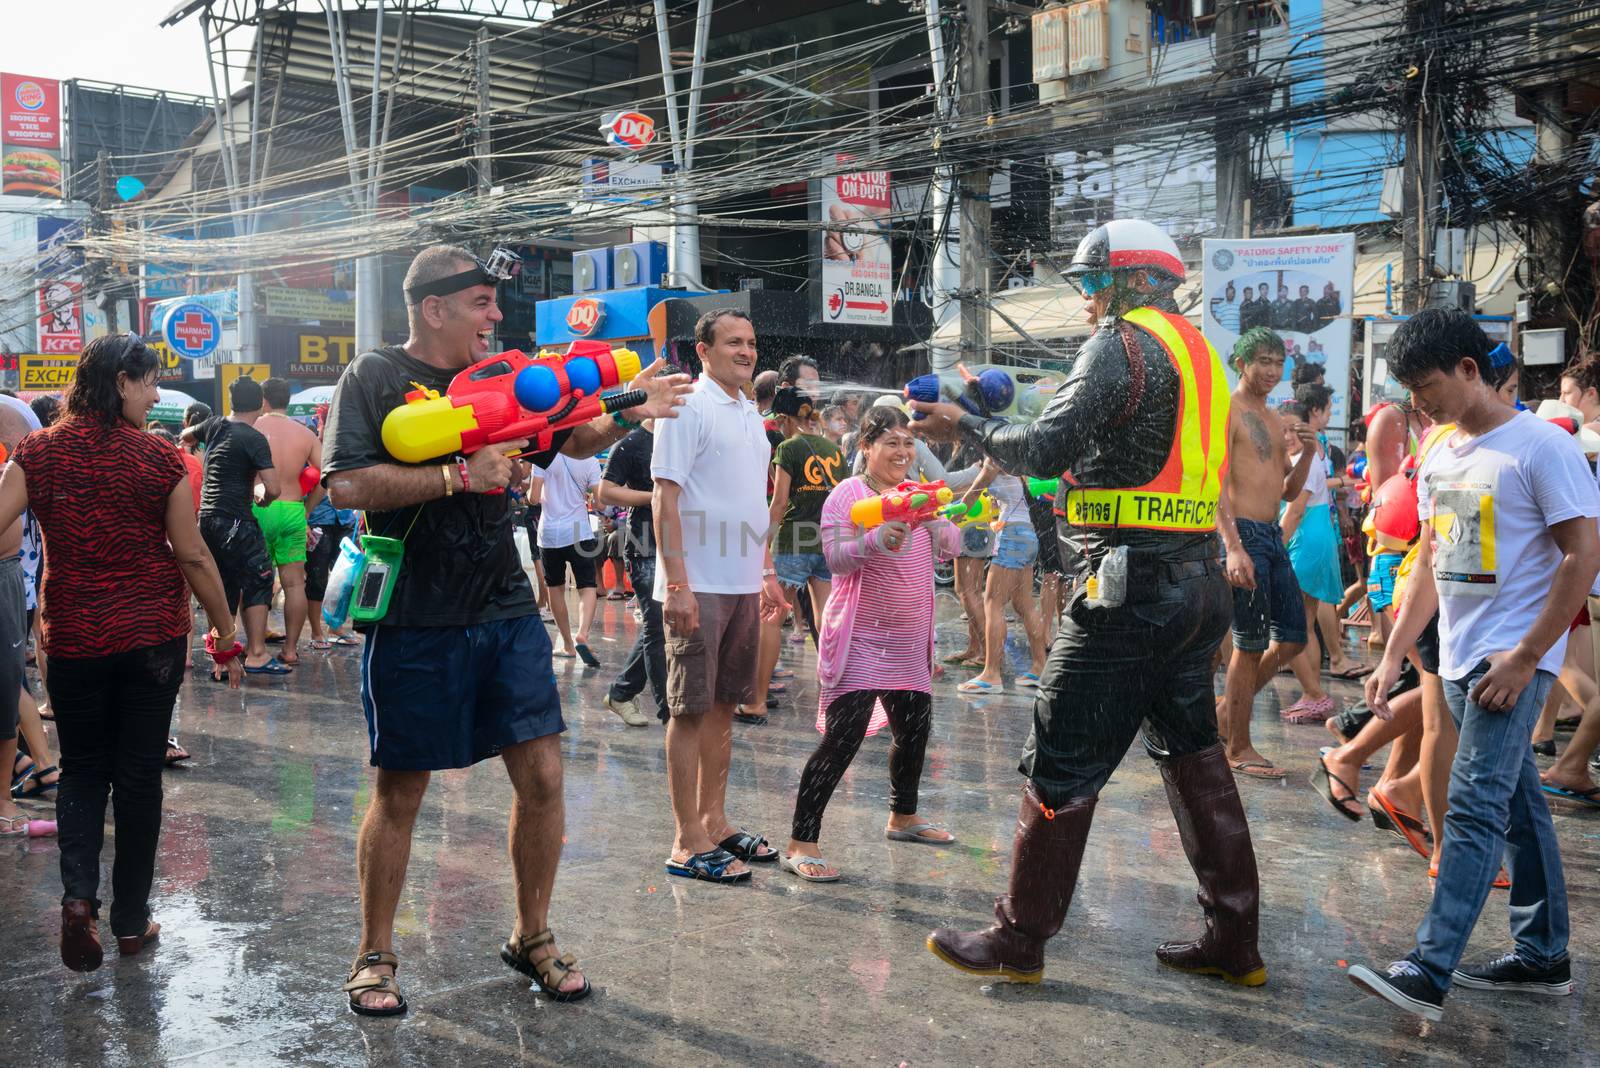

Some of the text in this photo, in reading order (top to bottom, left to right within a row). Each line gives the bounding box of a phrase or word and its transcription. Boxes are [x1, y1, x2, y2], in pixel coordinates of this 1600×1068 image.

[9, 114, 37, 122] HOME
[619, 117, 650, 142] DQ
[842, 180, 887, 201] ON DUTY
[1279, 246, 1312, 255] SAFETY
[845, 281, 883, 298] DR.BANGLA
[570, 305, 596, 327] DQ
[175, 326, 212, 336] PHARMACY
[44, 338, 81, 351] KFC
[1134, 496, 1206, 525] TRAFFIC
